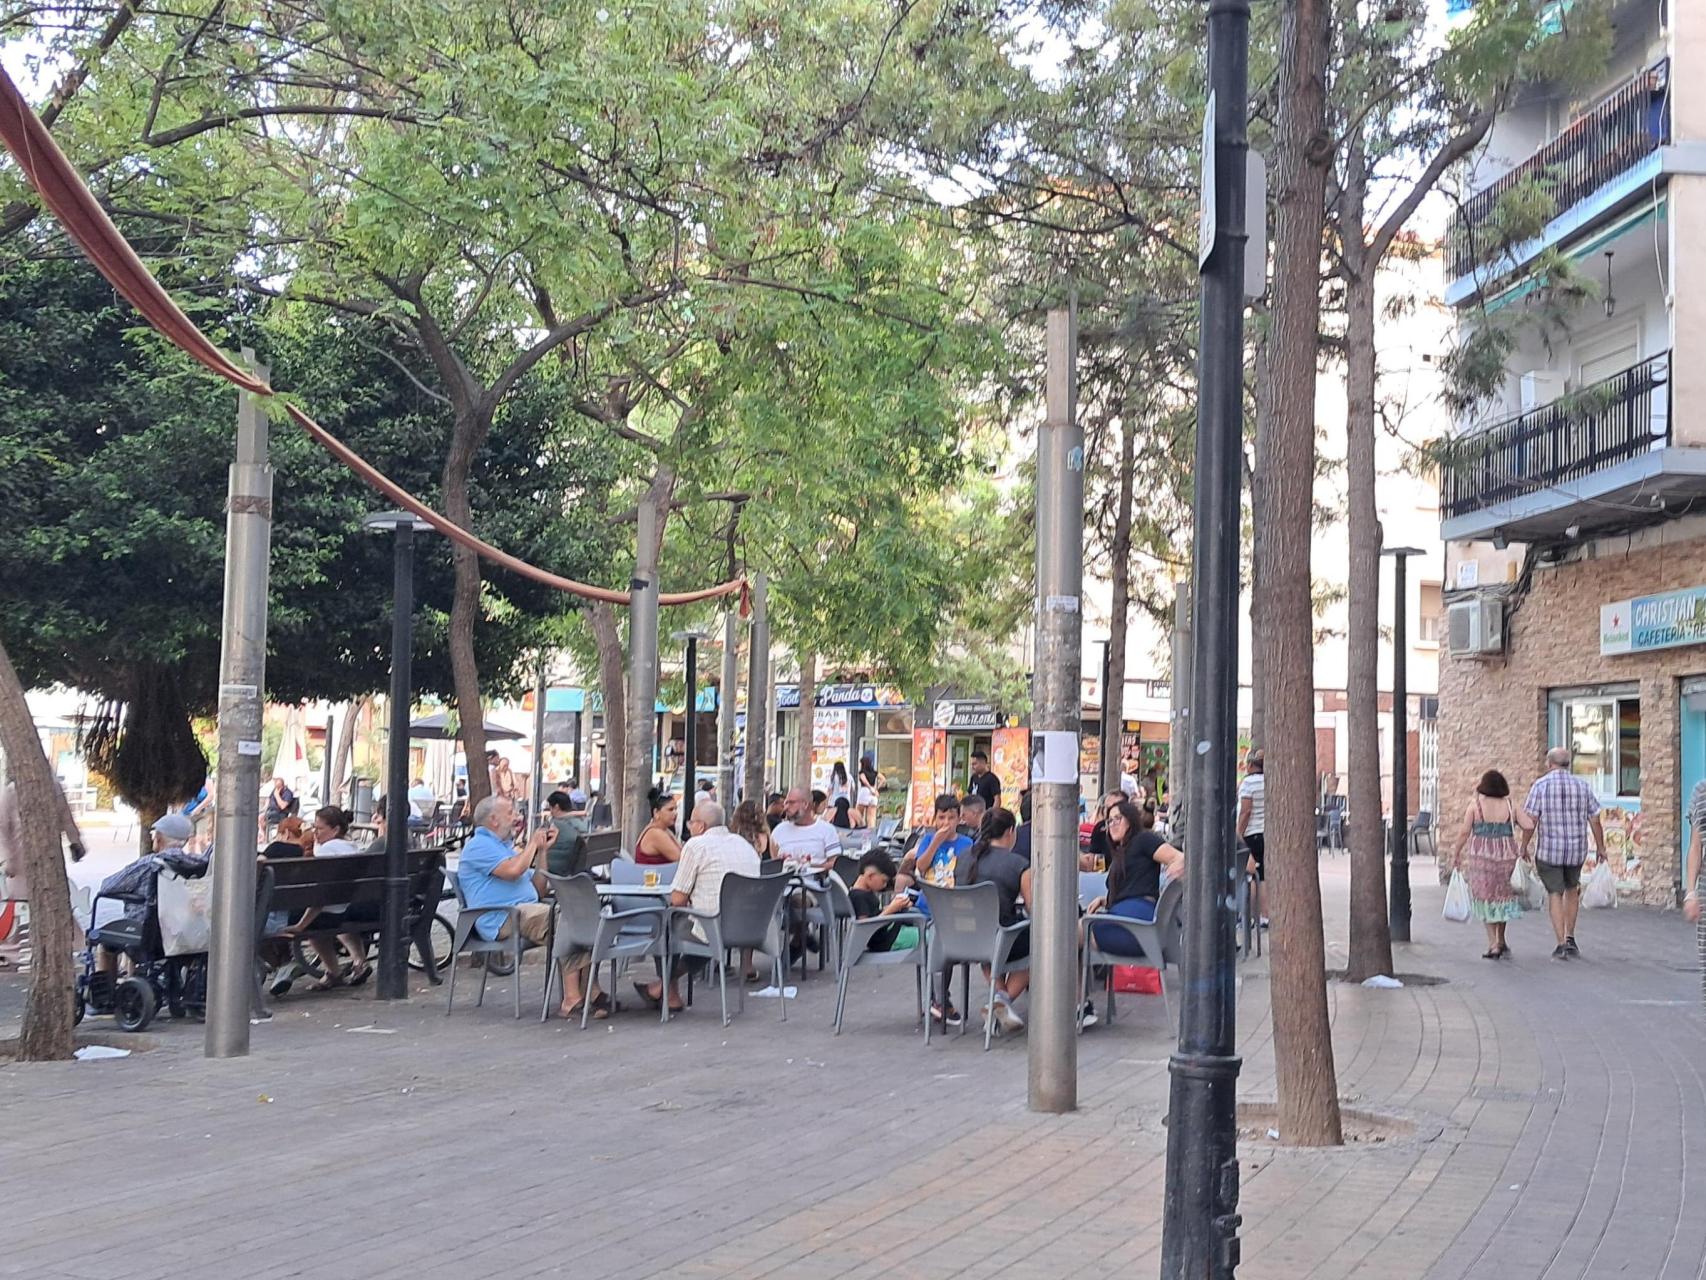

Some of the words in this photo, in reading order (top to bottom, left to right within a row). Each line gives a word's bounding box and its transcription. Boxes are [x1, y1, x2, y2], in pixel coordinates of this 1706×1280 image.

[1635, 594, 1696, 626] CHRISTIAN
[776, 688, 800, 706] Food
[820, 684, 859, 706] Panda
